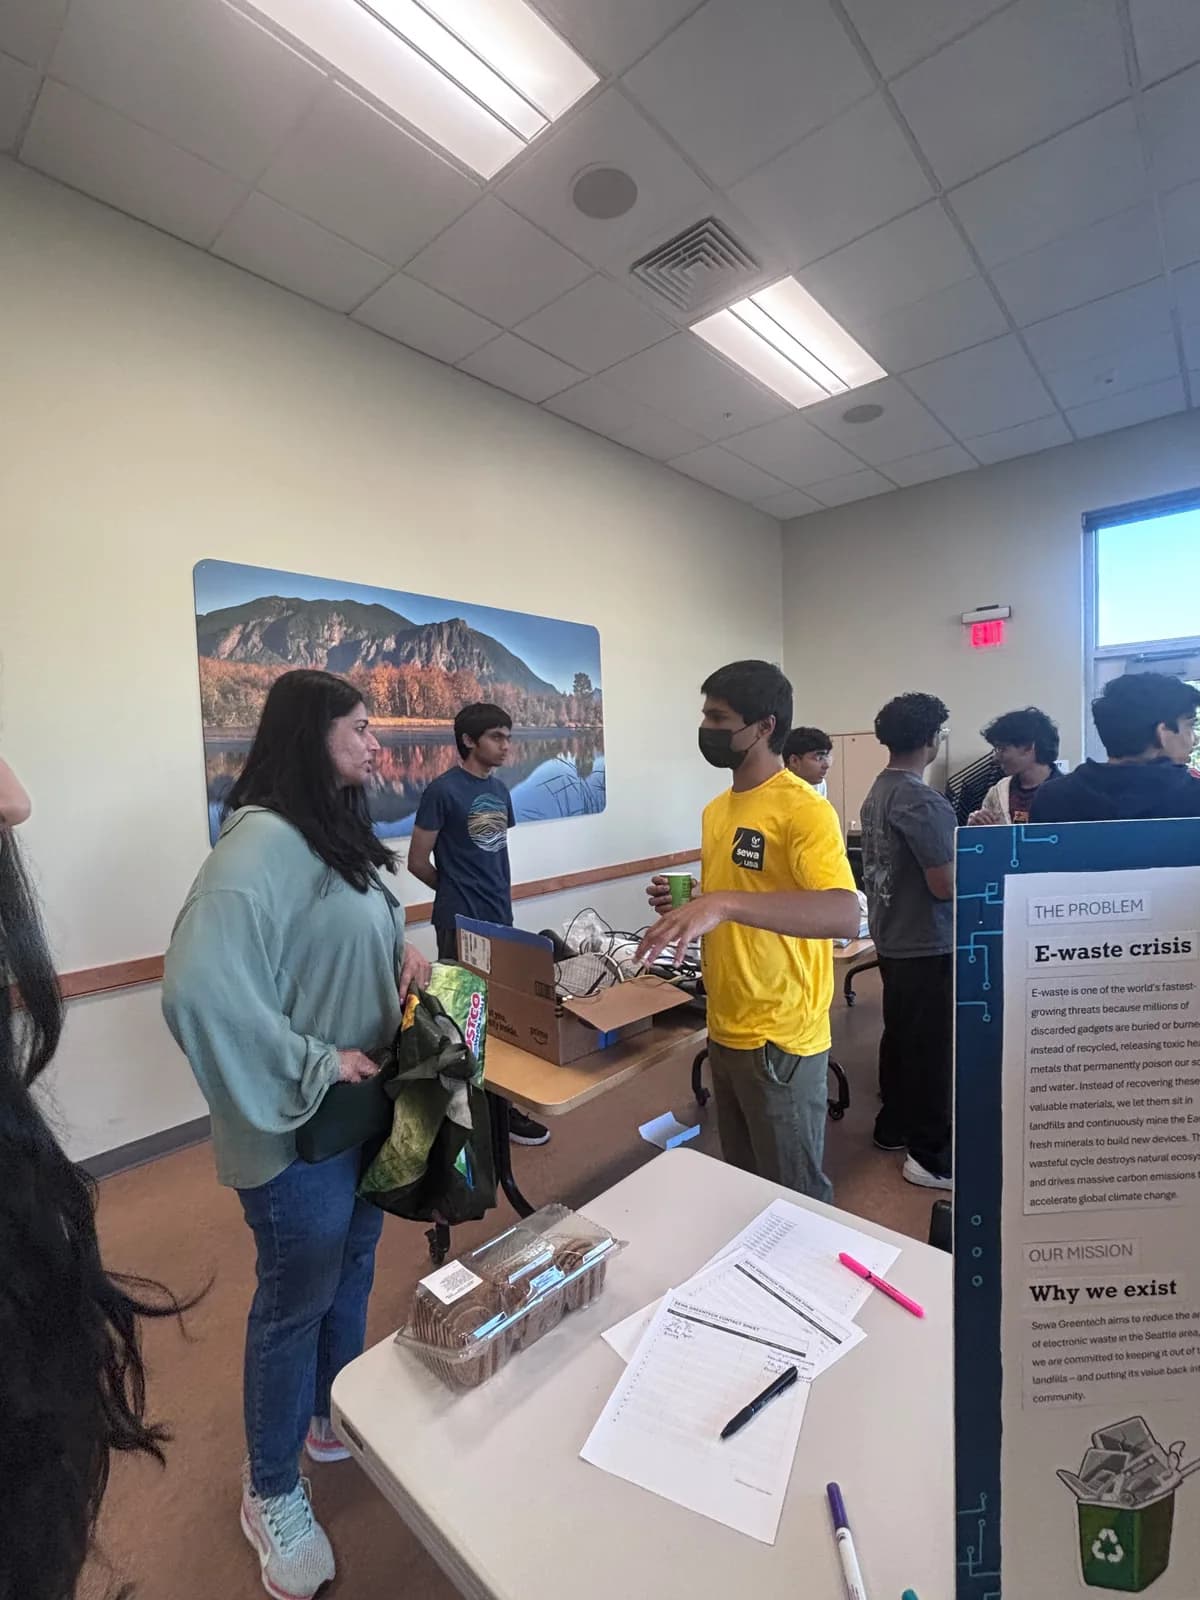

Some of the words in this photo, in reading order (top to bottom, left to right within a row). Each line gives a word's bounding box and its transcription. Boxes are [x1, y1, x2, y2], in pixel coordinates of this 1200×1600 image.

[736, 848, 760, 860] sewa
[1034, 904, 1064, 918] THE
[1068, 898, 1143, 916] PROBLEM
[1034, 942, 1122, 962] E-waste
[1129, 936, 1191, 956] crisis
[1031, 988, 1070, 997] E-waste
[1070, 986, 1079, 995] is
[1080, 987, 1098, 995] one
[1099, 985, 1109, 994] of
[1110, 985, 1125, 994] the
[1126, 983, 1160, 992] world's
[1161, 982, 1196, 991] fastest-
[1031, 1006, 1067, 1018] growing
[1067, 1006, 1100, 1015] threats
[1102, 1003, 1141, 1013] because
[1142, 1002, 1178, 1011] millions
[1180, 1000, 1189, 1010] of
[466, 992, 481, 1048] STCO
[1030, 1024, 1076, 1036] discarded
[1076, 1024, 1114, 1036] gadgets
[1114, 1024, 1130, 1032] are
[1131, 1021, 1160, 1031] buried
[1161, 1022, 1171, 1030] or
[1030, 1043, 1064, 1054] instead
[1065, 1043, 1076, 1053] of
[1076, 1041, 1119, 1054] recycled,
[1120, 1040, 1162, 1051] releasing
[1162, 1040, 1185, 1048] toxic
[1186, 1039, 1200, 1047] hea
[1030, 1064, 1062, 1074] metals
[1063, 1063, 1082, 1072] that
[1083, 1060, 1141, 1072] permanently
[1142, 1059, 1173, 1070] poison
[1174, 1059, 1189, 1067] our
[1030, 1083, 1047, 1093] and
[1048, 1083, 1078, 1092] water.
[1079, 1080, 1114, 1090] Instead
[1115, 1079, 1124, 1088] of
[1125, 1078, 1174, 1088] recovering
[1174, 1077, 1200, 1086] these
[1029, 1101, 1068, 1112] valuable
[1069, 1099, 1115, 1111] materials,
[1116, 1100, 1131, 1108] we
[1132, 1098, 1145, 1107] let
[1146, 1097, 1170, 1106] them
[1171, 1096, 1183, 1105] sit
[1184, 1096, 1193, 1104] in
[1029, 1120, 1066, 1130] landfills
[1067, 1119, 1084, 1128] and
[1086, 1116, 1144, 1128] continuously
[1145, 1115, 1168, 1125] mine
[1170, 1115, 1185, 1124] the
[1029, 1139, 1052, 1149] fresh
[1053, 1137, 1094, 1148] minerals
[1094, 1138, 1105, 1146] to
[1106, 1136, 1129, 1145] build
[1131, 1136, 1151, 1144] new
[1029, 1158, 1068, 1168] wasteful
[1069, 1156, 1096, 1168] cycle
[1096, 1156, 1136, 1166] destroys
[1136, 1153, 1169, 1164] natural
[1029, 1177, 1046, 1187] and
[1047, 1176, 1076, 1186] drives
[1076, 1174, 1115, 1184] massive
[1116, 1174, 1148, 1183] carbon
[1149, 1171, 1196, 1181] emissions
[1029, 1195, 1077, 1206] accelerate
[1078, 1193, 1106, 1205] global
[1108, 1192, 1142, 1201] climate
[1028, 1247, 1063, 1262] OUR
[1066, 1243, 1132, 1259] MISSION
[1028, 1284, 1080, 1304] Why
[1085, 1286, 1117, 1299] we
[1124, 1279, 1176, 1297] exist
[1031, 1321, 1057, 1330] Sewa
[1058, 1316, 1106, 1328] Greentech
[1107, 1316, 1130, 1325] aims
[1131, 1315, 1141, 1323] to
[1142, 1313, 1174, 1322] reduce
[1175, 1312, 1190, 1320] the
[1032, 1340, 1041, 1348] of
[1042, 1336, 1088, 1348] electronic
[1088, 1335, 1117, 1344] waste
[1118, 1334, 1127, 1343] in
[1128, 1332, 1144, 1342] the
[1144, 1330, 1177, 1341] Seattle
[1047, 1358, 1062, 1366] are
[1063, 1352, 1114, 1365] committed
[1125, 1350, 1160, 1360] keeping
[1160, 1349, 1168, 1357] it
[1169, 1348, 1184, 1356] out
[1185, 1346, 1195, 1355] of
[1032, 1374, 1068, 1384] landfills
[1076, 1372, 1094, 1382] and
[1095, 1370, 1126, 1381] putting
[1127, 1369, 1139, 1377] its
[1140, 1368, 1165, 1376] value
[1166, 1365, 1187, 1375] back
